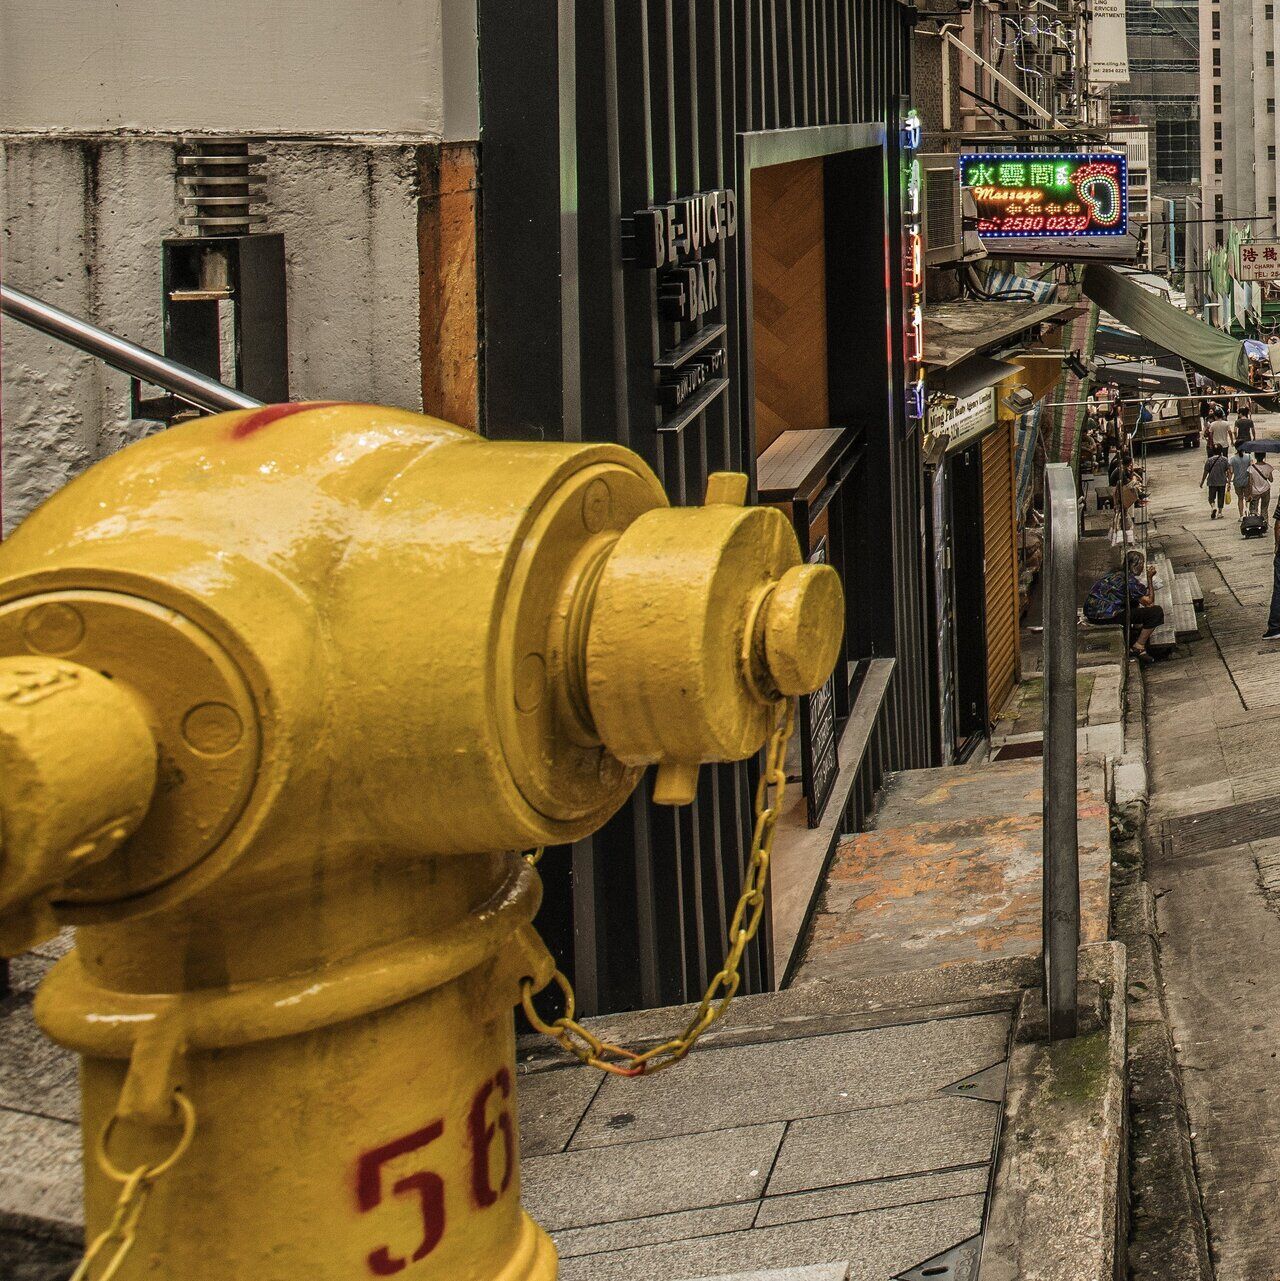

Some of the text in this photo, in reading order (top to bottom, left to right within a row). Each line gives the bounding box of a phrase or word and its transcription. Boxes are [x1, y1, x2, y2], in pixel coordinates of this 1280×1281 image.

[975, 187, 1042, 203] Massage
[1056, 165, 1068, 186] SPA
[654, 188, 738, 269] BE-JUICED
[1001, 217, 1044, 230] 2580
[1047, 217, 1087, 230] 0232
[688, 258, 717, 322] BAR
[352, 1066, 515, 1279] 56
